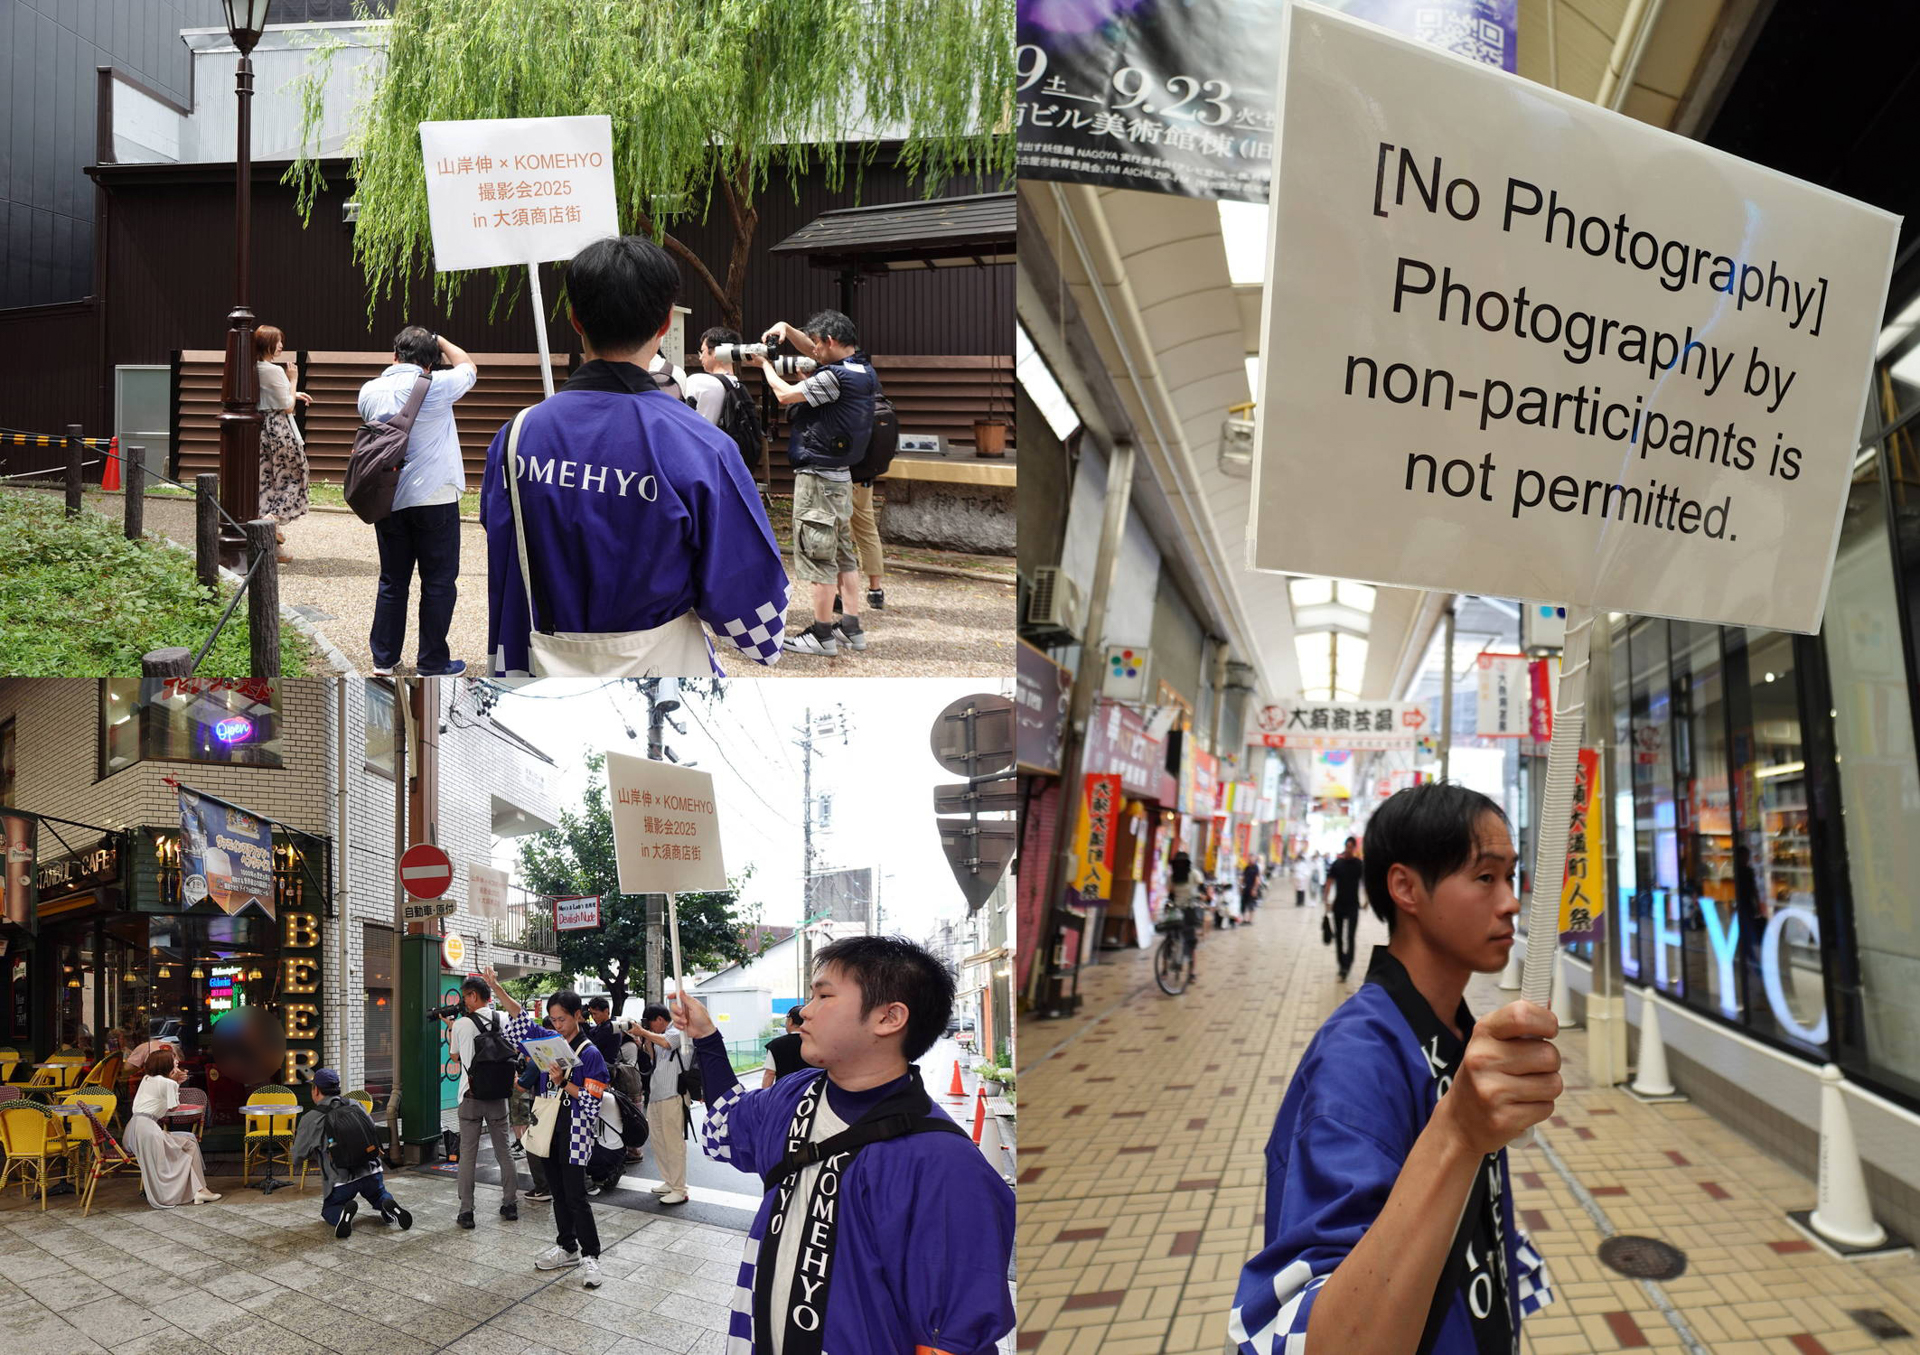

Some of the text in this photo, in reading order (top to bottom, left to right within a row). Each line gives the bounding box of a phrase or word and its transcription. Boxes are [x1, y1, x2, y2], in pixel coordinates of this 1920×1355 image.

[437, 155, 492, 175] 山岸伸
[515, 152, 603, 170] KOMEHYO
[1077, 149, 1118, 161] NAGOYA
[478, 180, 572, 202] 撮影会2025
[473, 205, 581, 228] in 大須商店街
[1373, 142, 1828, 337] [No Photography]
[1393, 257, 1796, 413] Photography by
[1345, 355, 1802, 480] non-participants is
[1405, 451, 1737, 541] not permitted.
[216, 722, 249, 743] Open
[618, 787, 652, 807] 山岸伸
[664, 795, 713, 815] KOMEHYO
[644, 816, 697, 836] 撮影会2025
[81, 849, 110, 876] CAFE
[641, 843, 701, 861] in 大須商店街
[405, 904, 454, 919] 自動車・原付
[282, 911, 320, 1085] BEER
[793, 1151, 850, 1332] KOMEHYO
